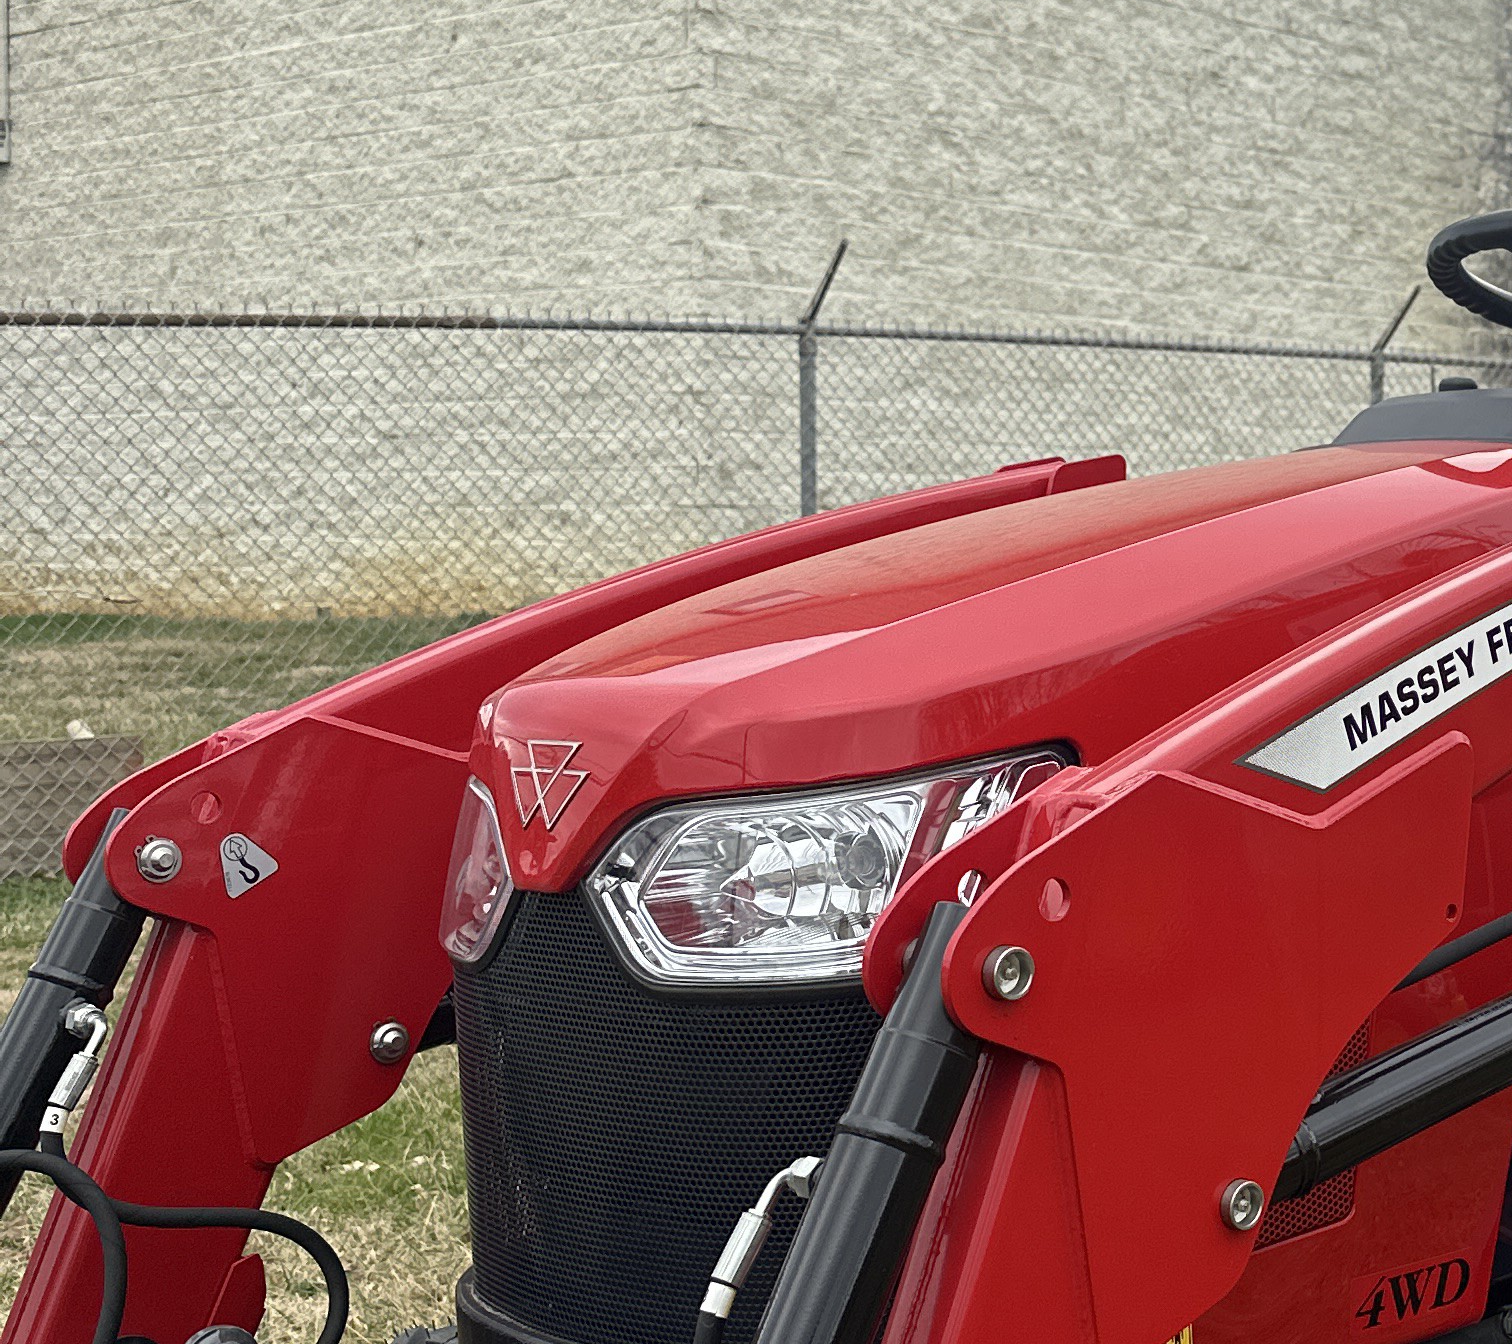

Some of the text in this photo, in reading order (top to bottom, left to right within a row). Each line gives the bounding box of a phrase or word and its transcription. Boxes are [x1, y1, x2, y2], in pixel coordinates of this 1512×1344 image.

[1342, 639, 1475, 752] MASSEY
[50, 1114, 60, 1126] 3
[1355, 1257, 1471, 1330] 4WD
